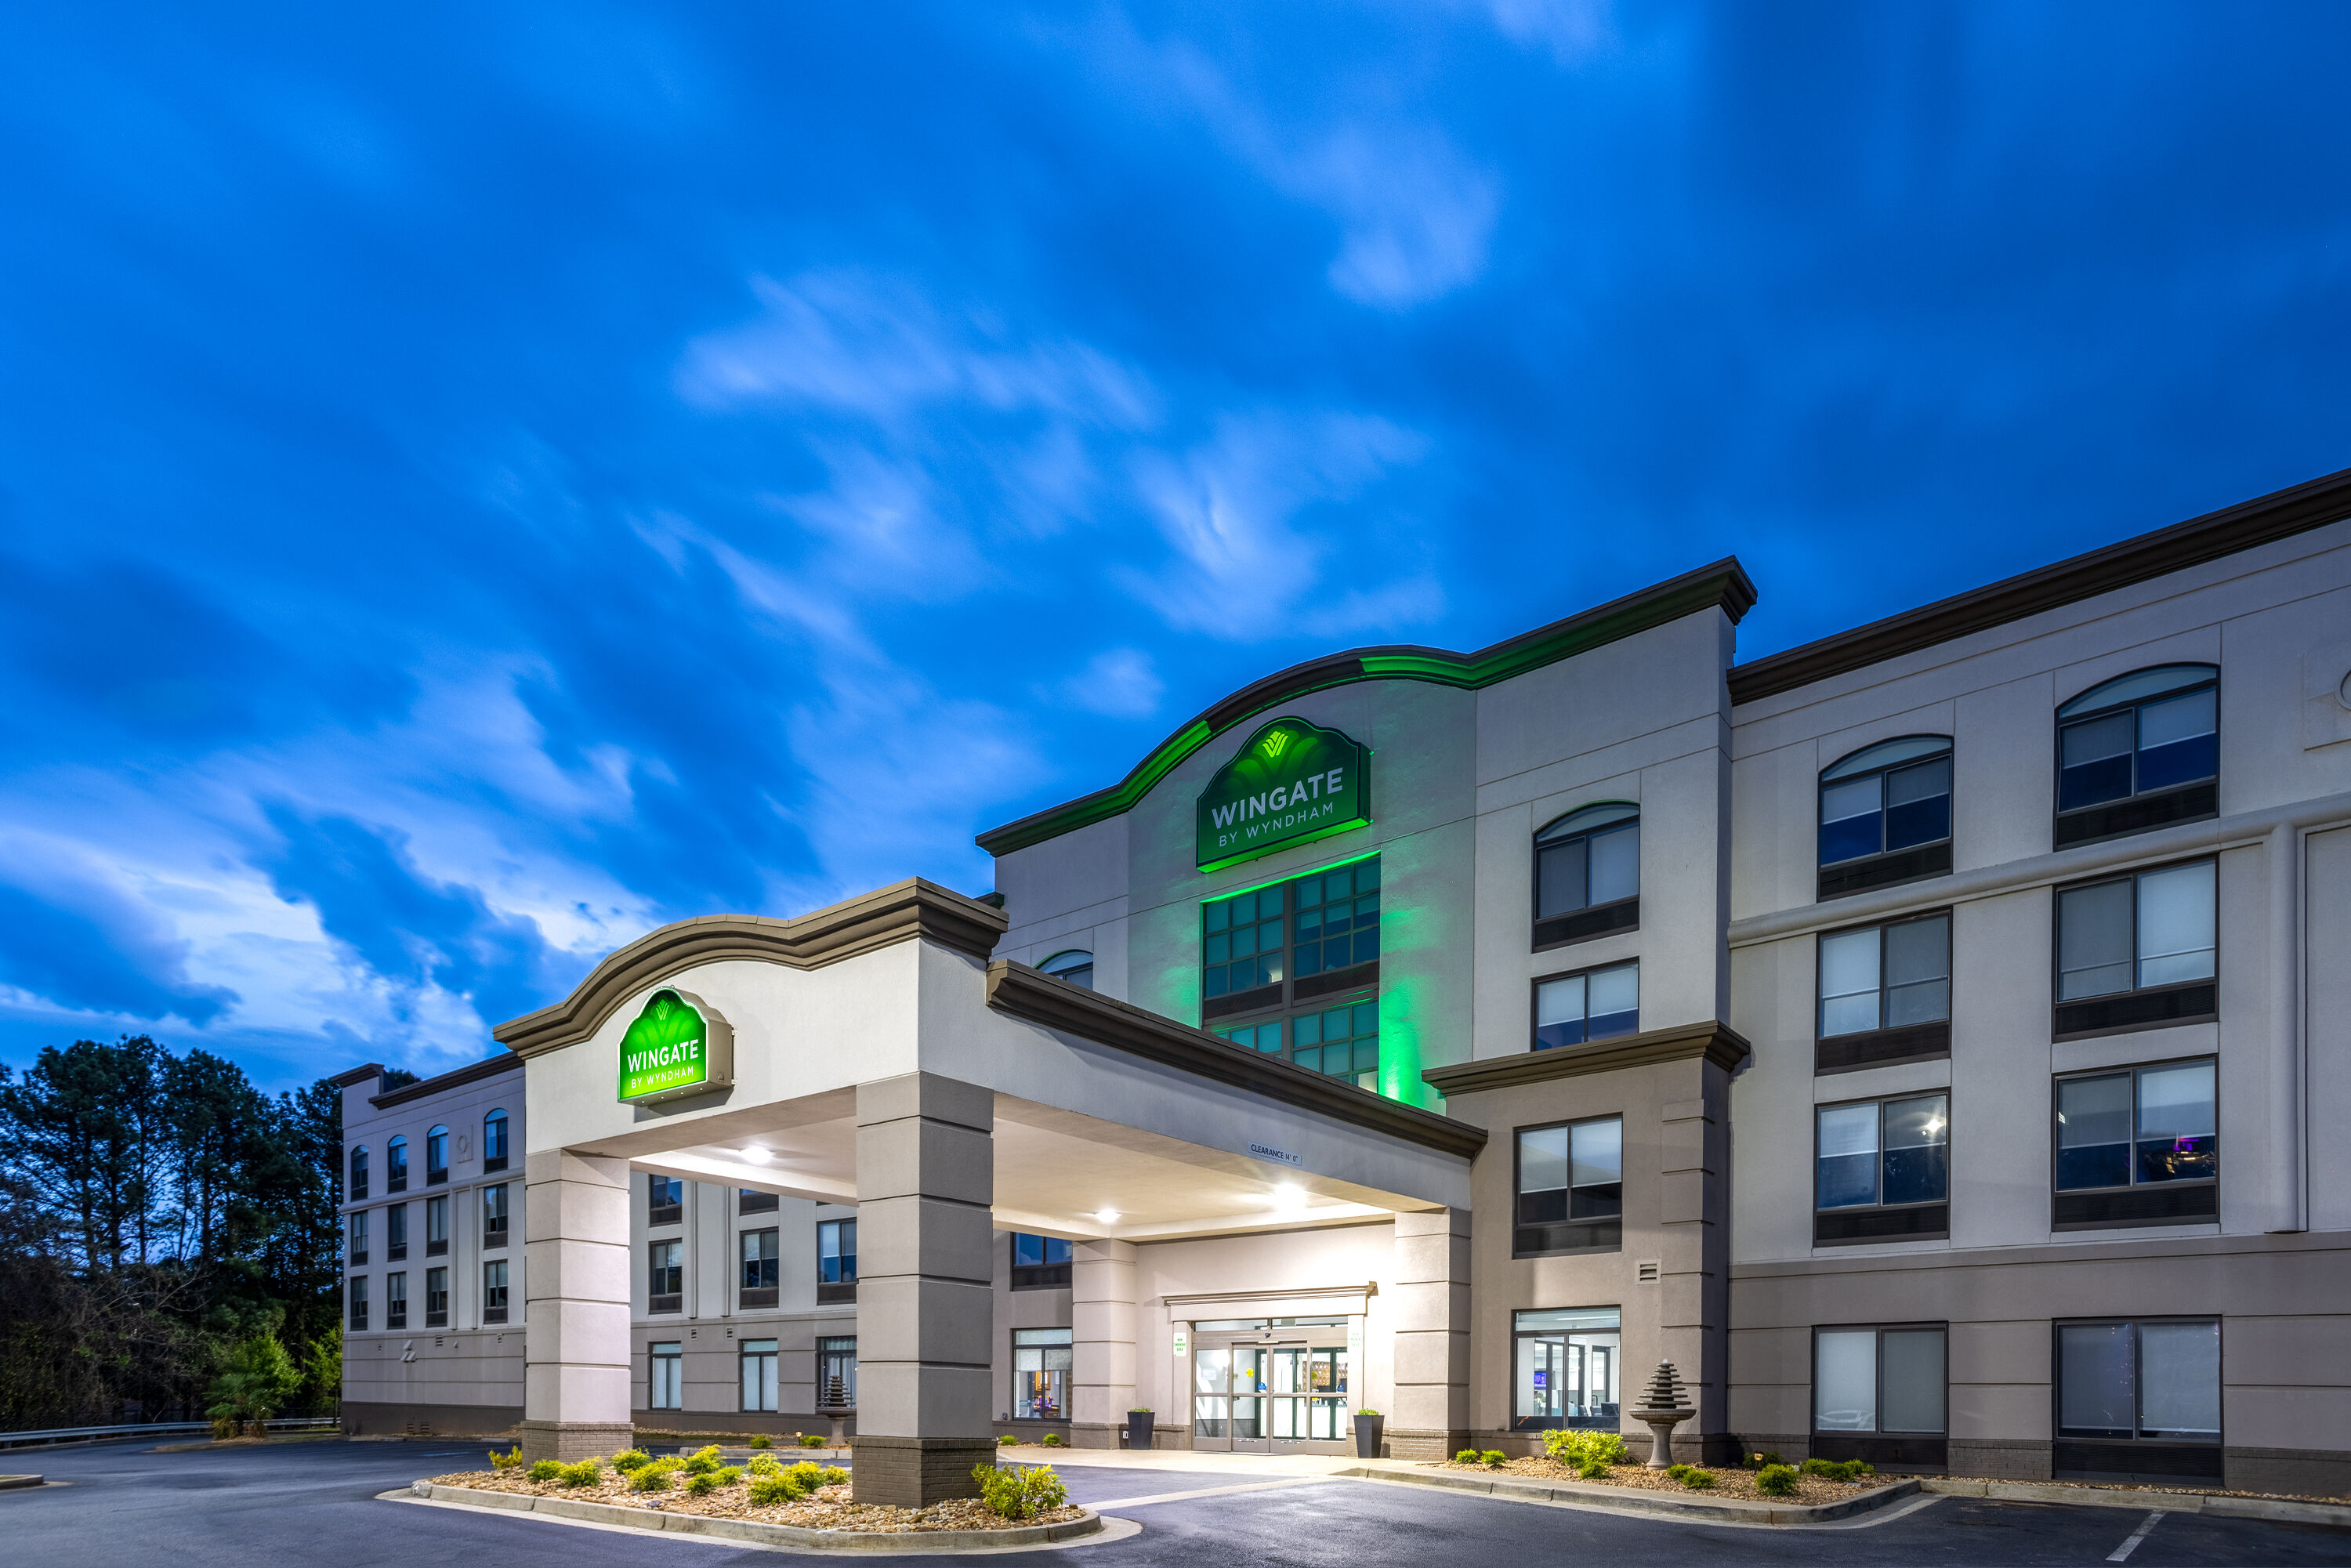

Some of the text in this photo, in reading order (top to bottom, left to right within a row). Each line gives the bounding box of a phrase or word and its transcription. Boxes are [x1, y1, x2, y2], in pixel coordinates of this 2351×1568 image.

[1212, 767, 1343, 830] WINGATE
[1219, 802, 1333, 847] BY WYNDHAM
[627, 1039, 699, 1073] WINGATE
[632, 1066, 694, 1088] BY WYNDHAM
[1251, 1143, 1284, 1160] CLEARANCE
